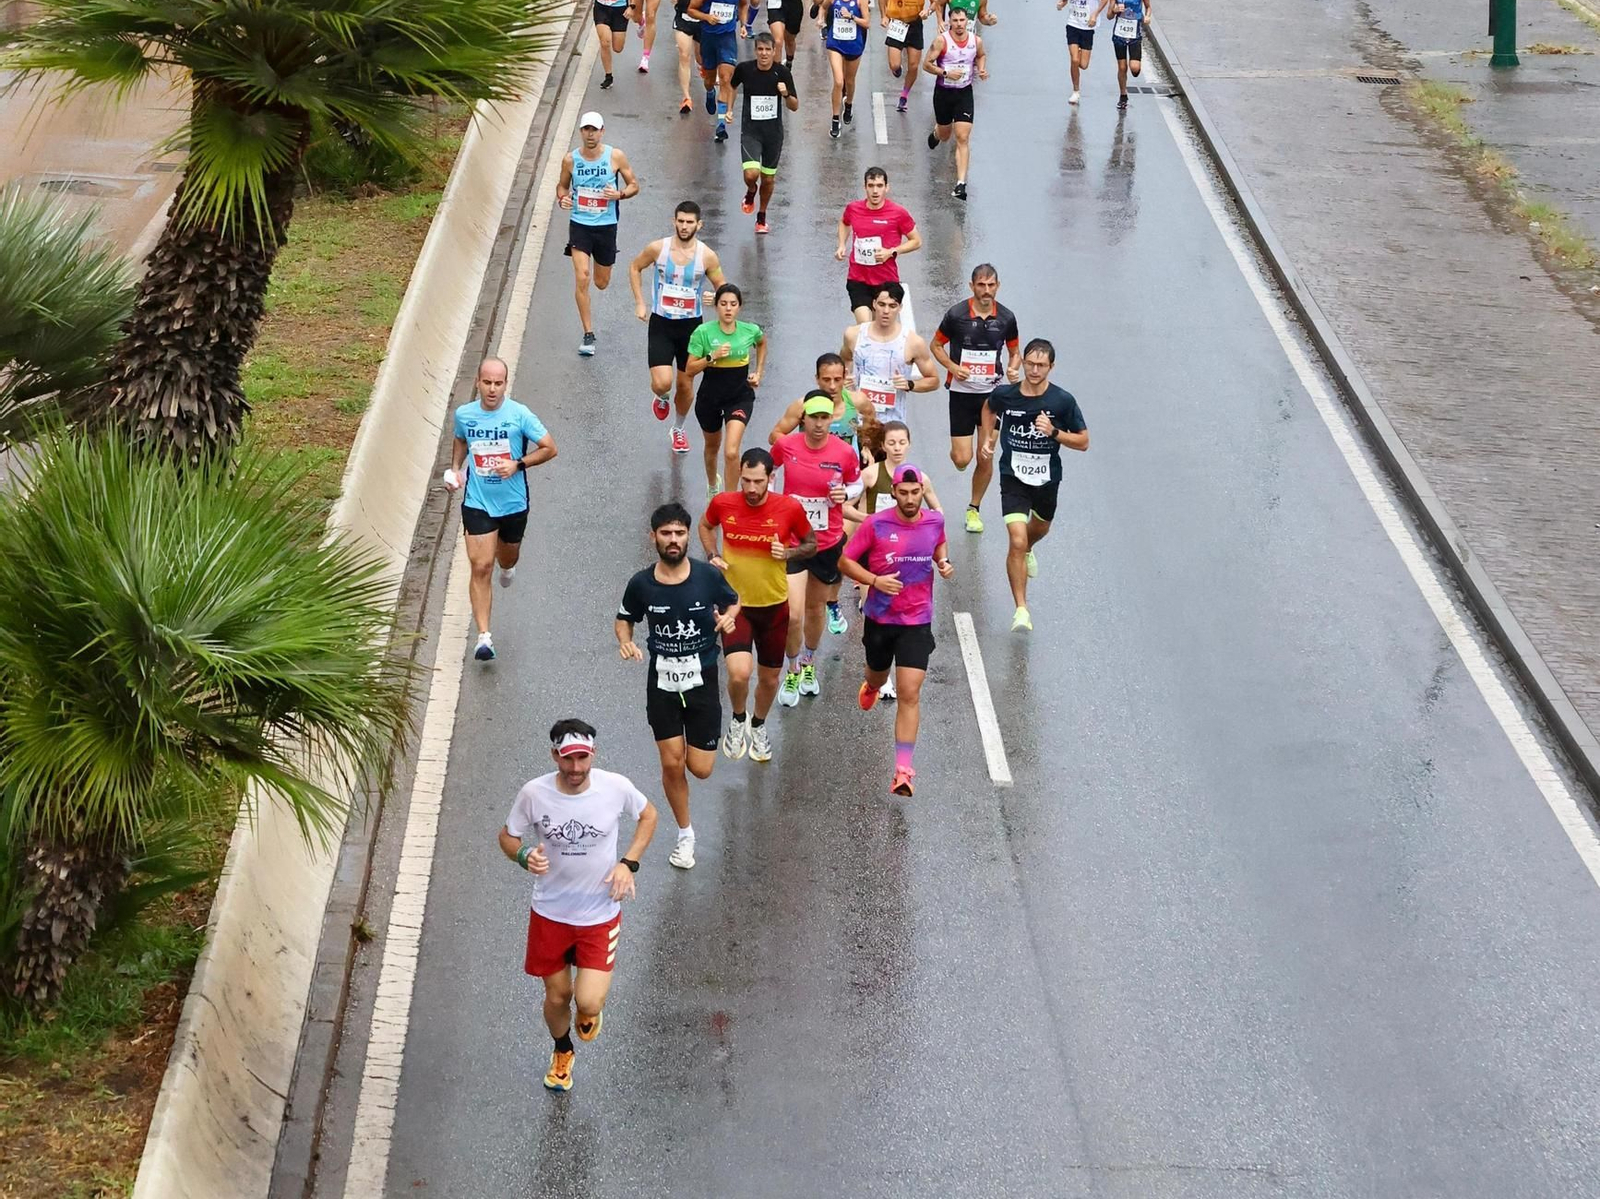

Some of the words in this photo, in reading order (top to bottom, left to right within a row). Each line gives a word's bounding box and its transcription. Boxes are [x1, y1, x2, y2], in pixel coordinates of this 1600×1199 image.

[755, 103, 774, 113] 5082
[576, 166, 608, 177] nerja
[586, 199, 599, 207] 58
[671, 299, 685, 308] 36
[968, 364, 988, 375] 265
[867, 392, 887, 404] 343
[466, 426, 509, 441] nerja
[1016, 465, 1047, 475] 10240
[665, 671, 695, 683] 1070
